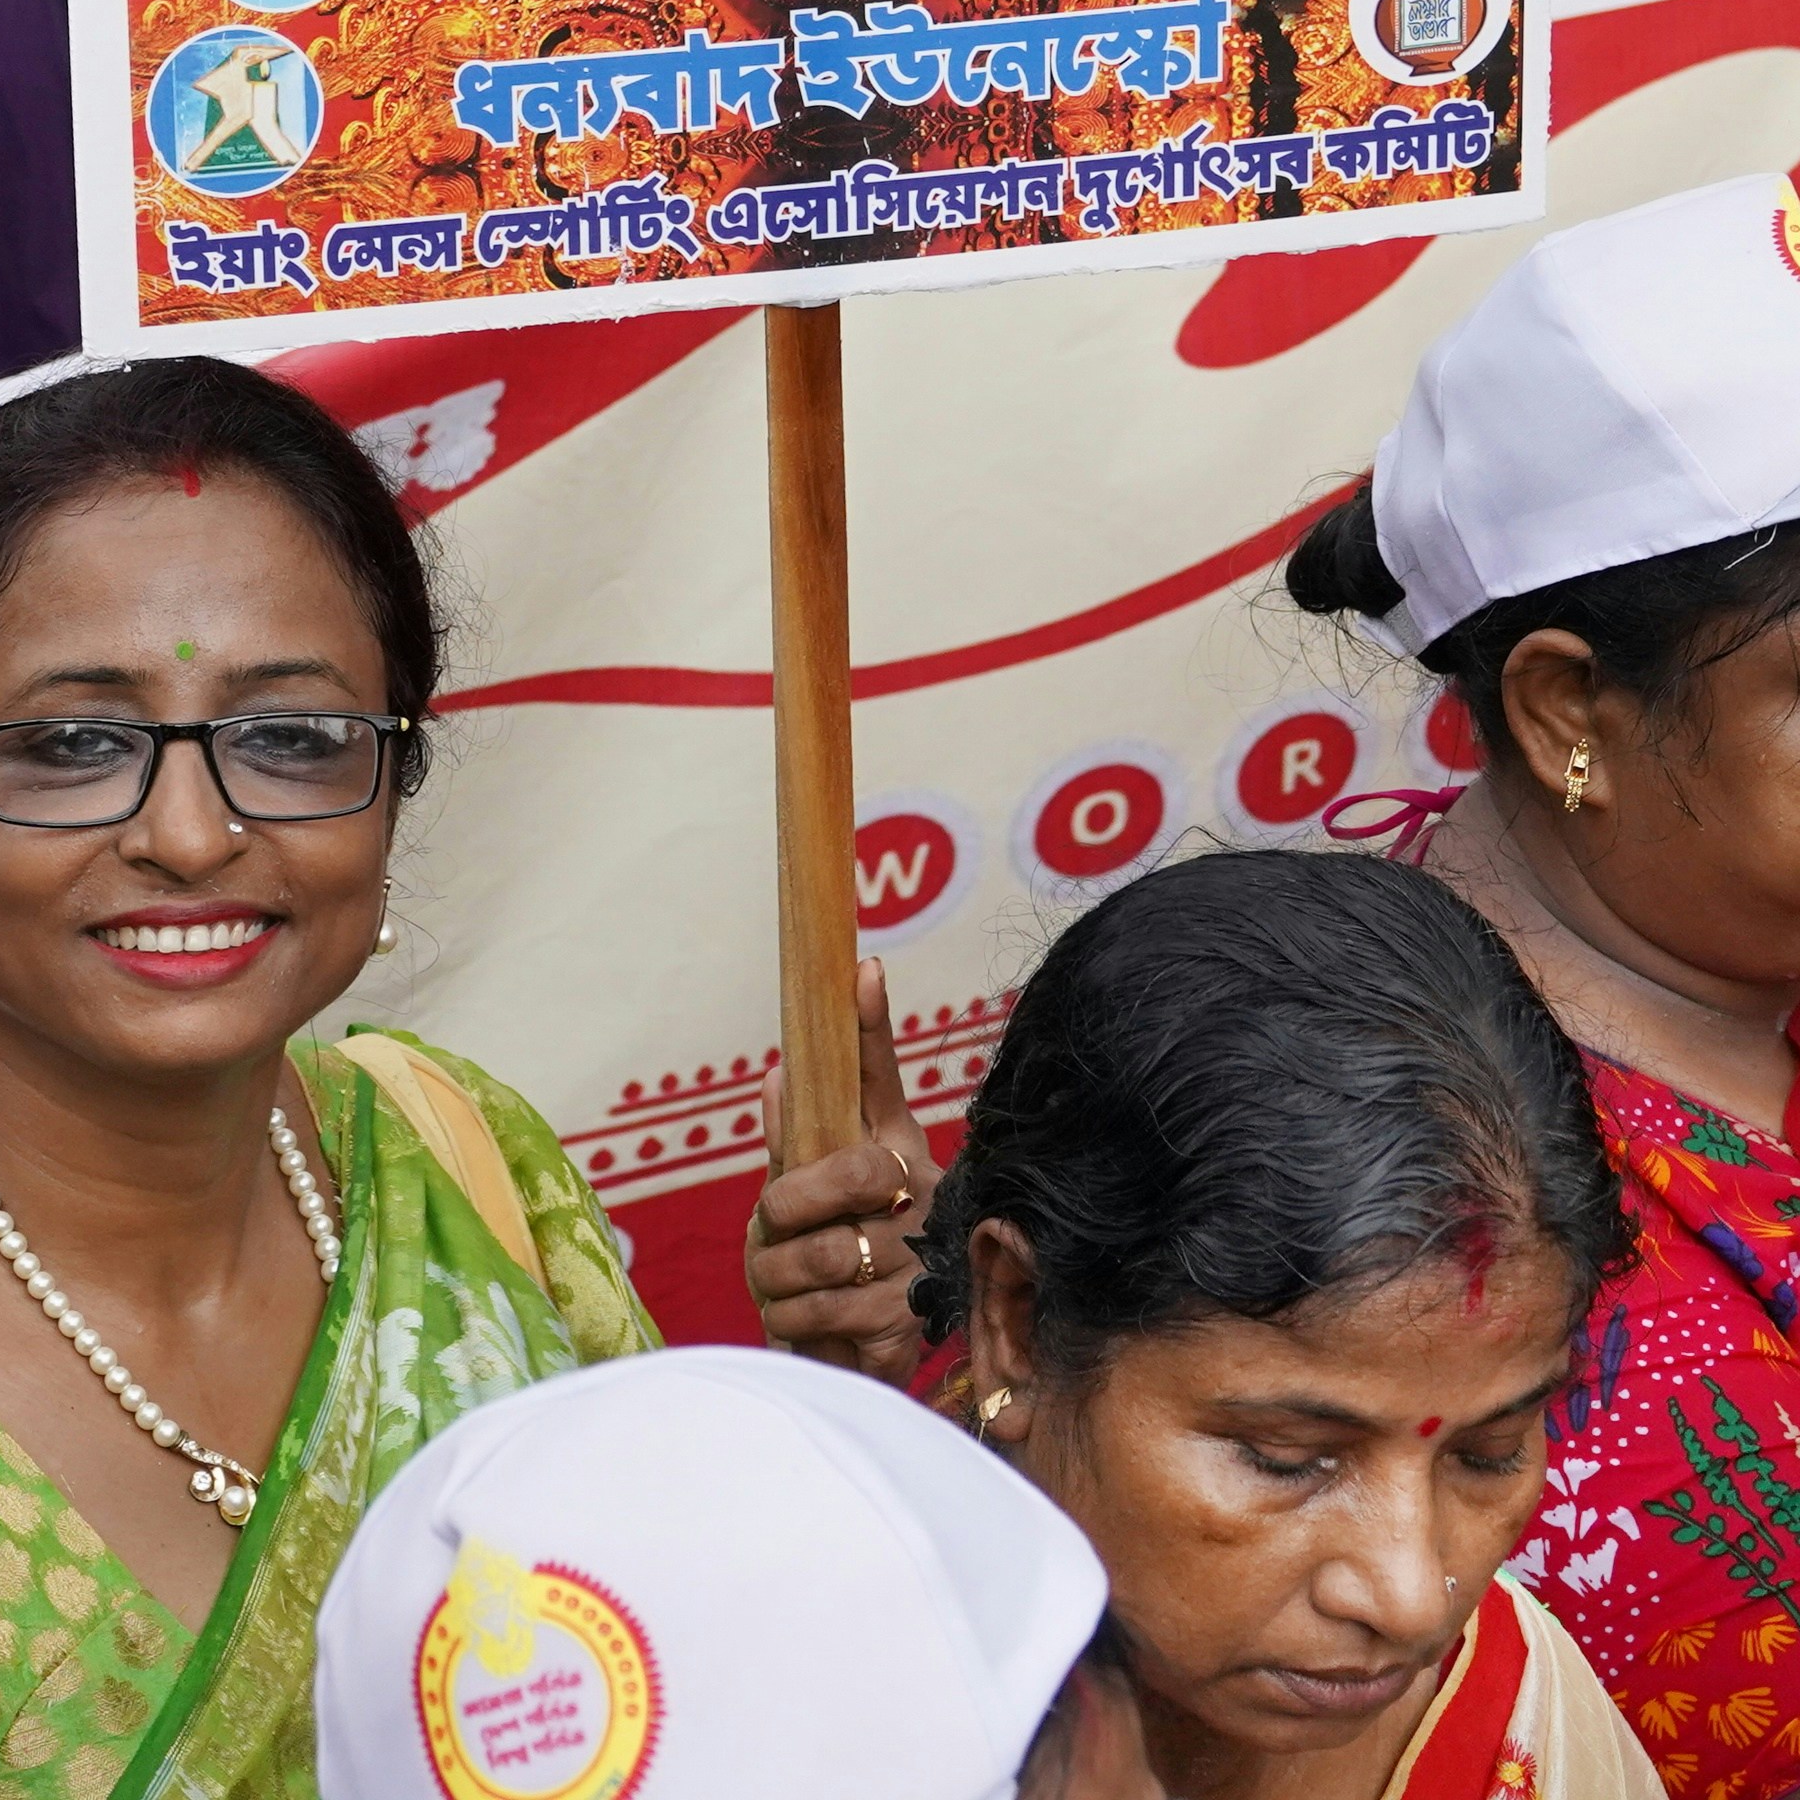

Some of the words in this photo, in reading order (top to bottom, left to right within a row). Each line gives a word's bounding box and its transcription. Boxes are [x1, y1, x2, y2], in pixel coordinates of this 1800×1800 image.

[451, 31, 786, 148] ধন্যবাদ
[164, 218, 321, 297] ইয়াং
[324, 212, 470, 283] মেন্স
[474, 169, 704, 270] স্পোর্টিং
[710, 152, 1067, 247] এসোসিয়েশন
[1075, 120, 1316, 237] দুর্গোৎসব
[1321, 96, 1498, 182] কমিটি
